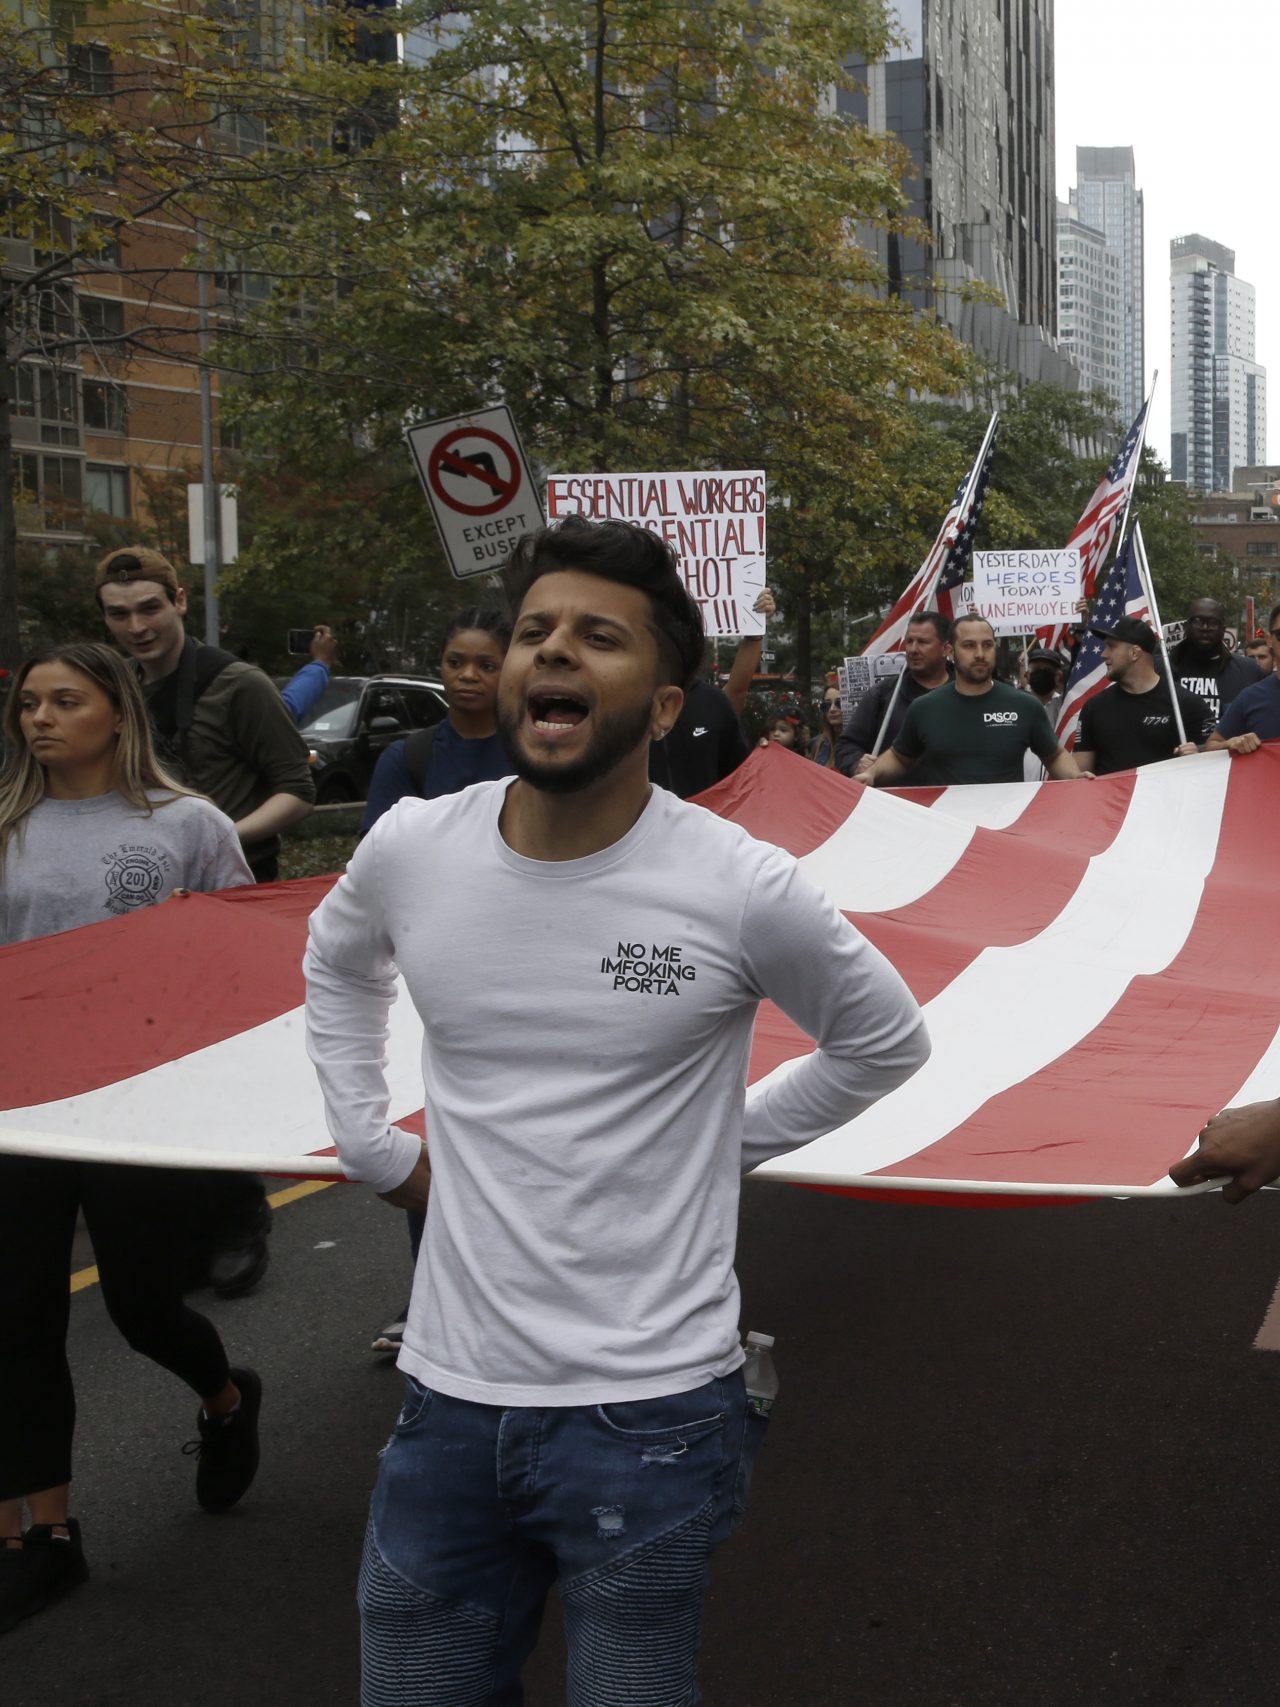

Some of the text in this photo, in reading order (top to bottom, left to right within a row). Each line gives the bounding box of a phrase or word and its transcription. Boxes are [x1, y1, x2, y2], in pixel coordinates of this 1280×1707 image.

[549, 476, 764, 518] ESSENTIAL WORKERS
[462, 513, 527, 543] EXCEPT
[473, 536, 518, 561] BUSE
[975, 552, 1077, 569] YESTERDAY'S
[676, 557, 738, 598] HOT
[986, 571, 1076, 586] HEROES
[998, 585, 1061, 597] TODAY'S
[980, 601, 1078, 618] UNEMPLOYED
[1143, 715, 1170, 725] 1776
[125, 872, 145, 887] 201
[616, 941, 682, 962] NO ME
[600, 956, 696, 981] IMFOKING
[613, 975, 680, 996] PORTA
